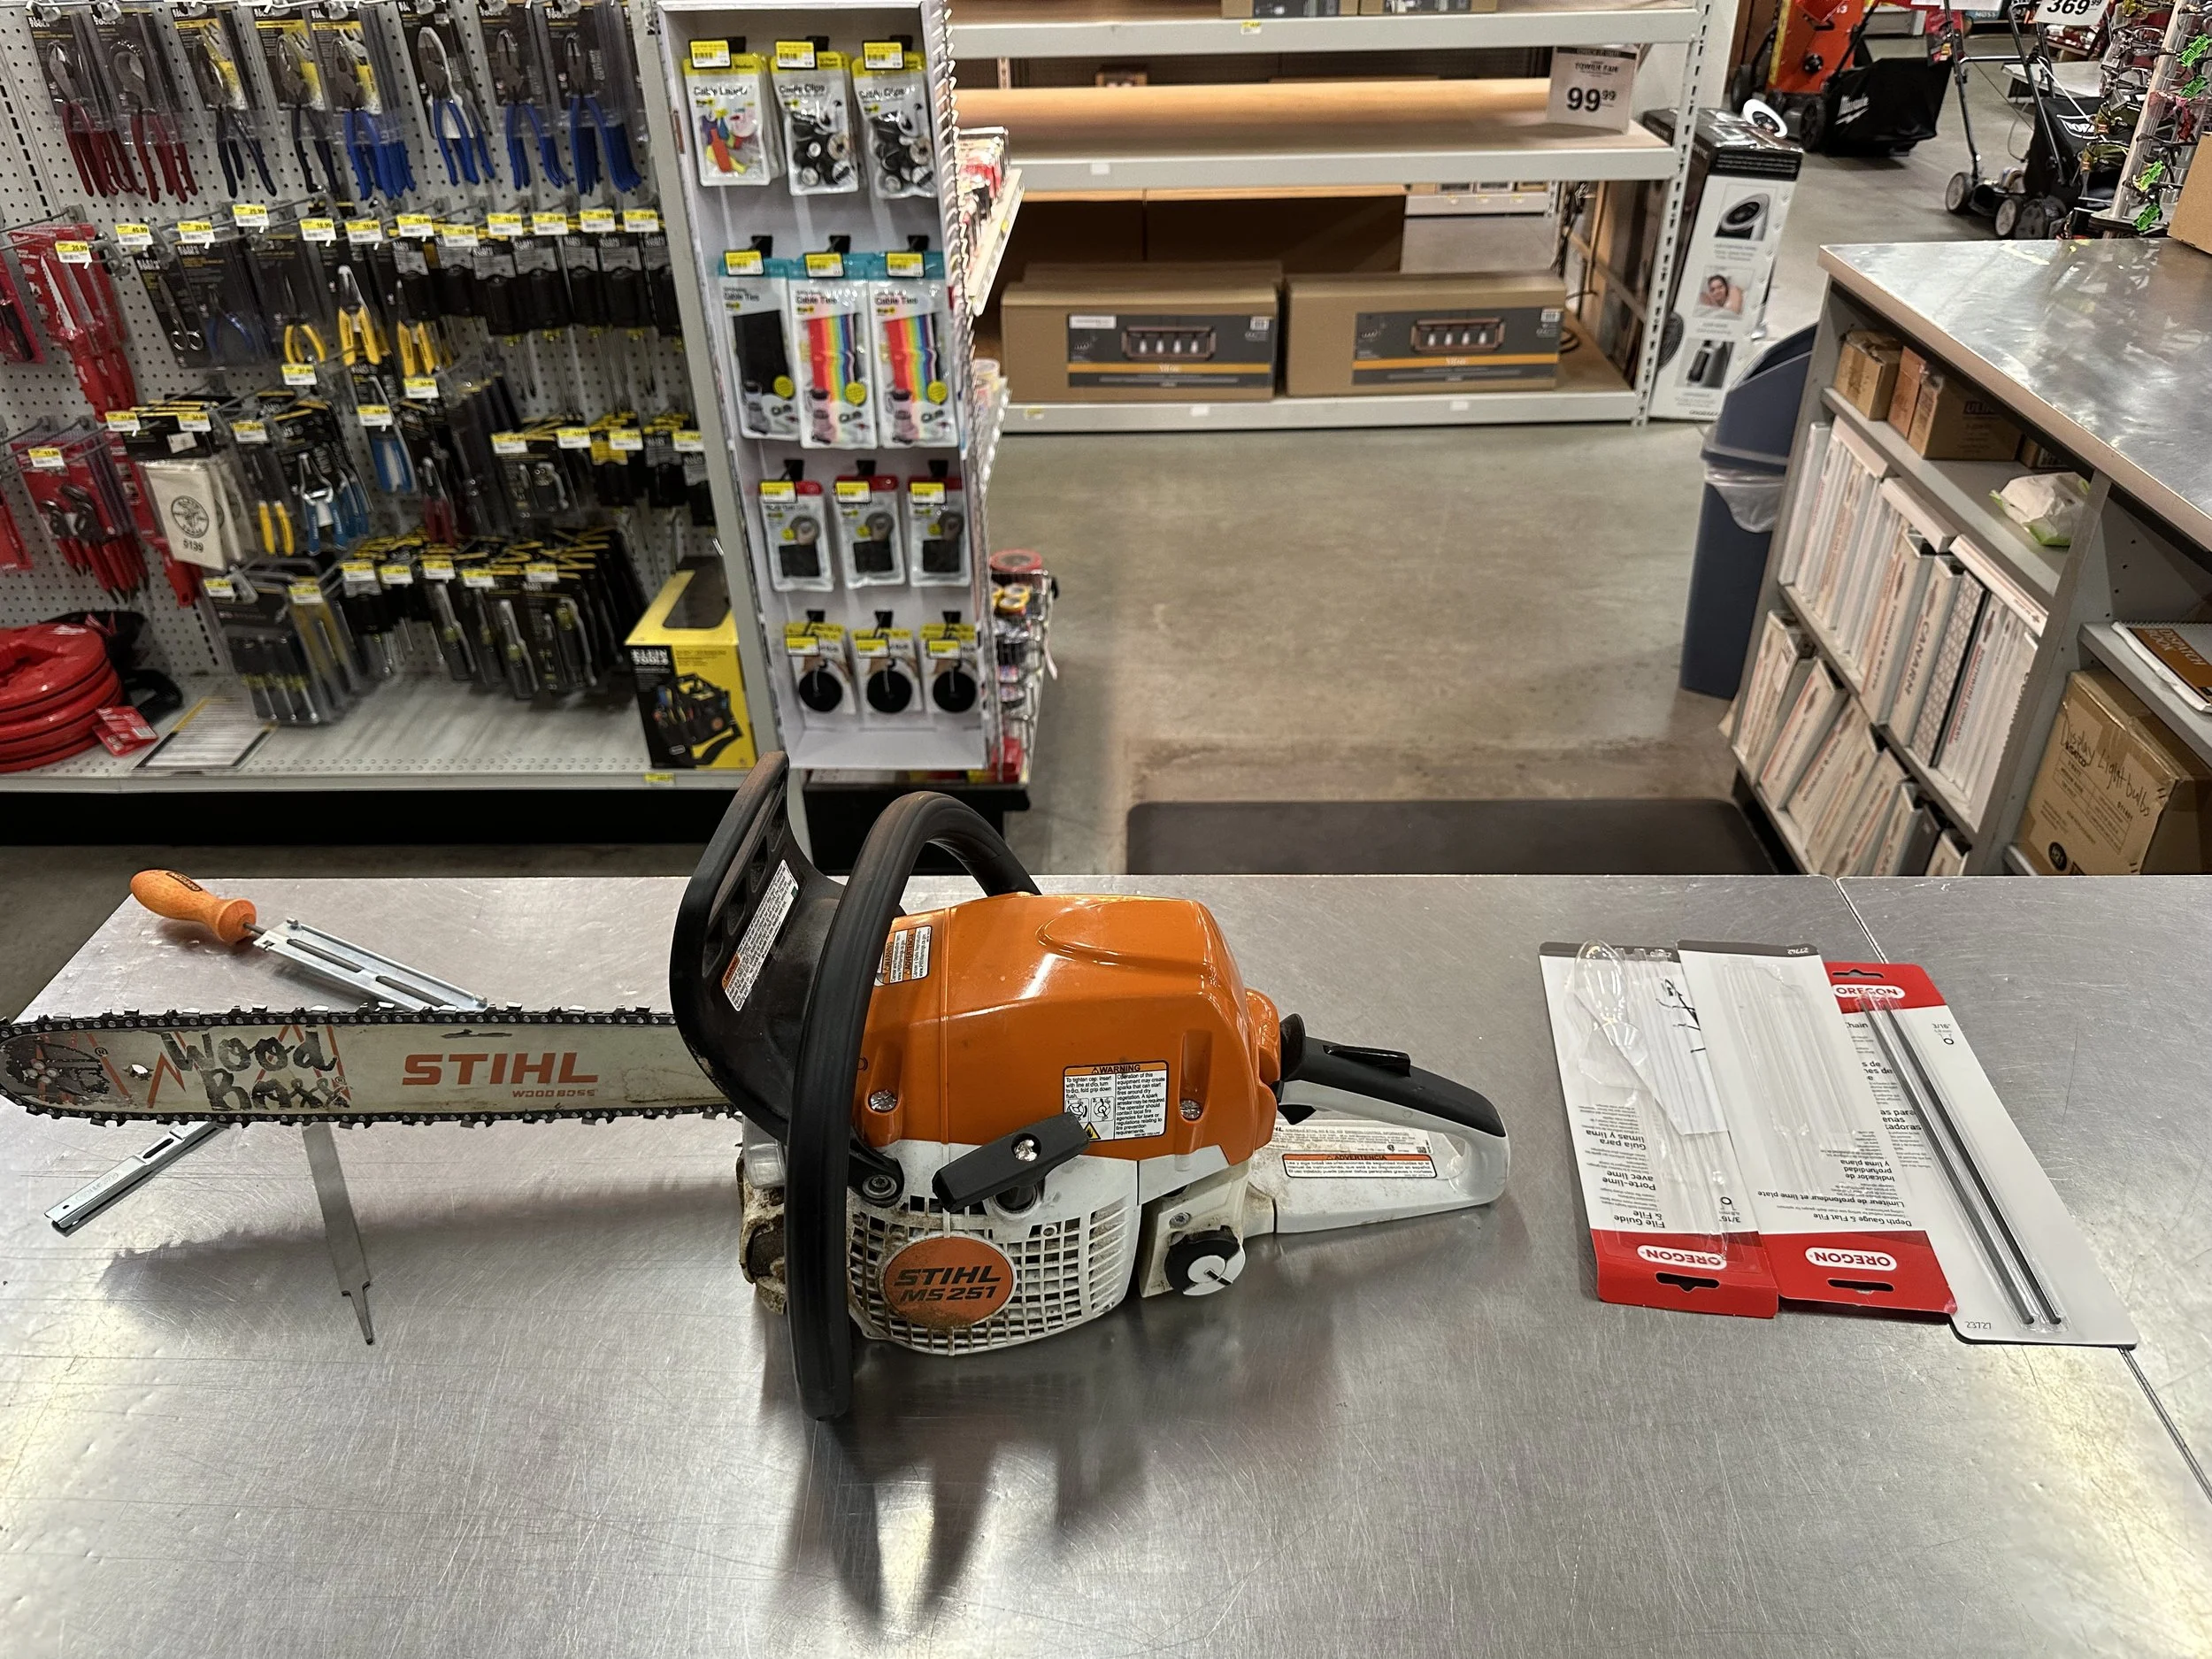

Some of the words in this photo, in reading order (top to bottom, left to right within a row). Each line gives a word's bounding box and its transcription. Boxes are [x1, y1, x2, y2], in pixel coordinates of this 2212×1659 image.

[2047, 0, 2089, 15] 369
[1566, 87, 1601, 111] 99
[182, 538, 204, 553] 5139
[1904, 621, 1930, 695] CANARM
[2098, 749, 2126, 790] Light
[1836, 987, 1898, 996] OREGON
[160, 1024, 339, 1072] Wood
[402, 1052, 599, 1086] STIHL
[1099, 1064, 1141, 1073] WARNING
[512, 1089, 554, 1098] WOOD
[1586, 1129, 1608, 1139] lima
[1617, 1133, 1645, 1143] limas
[1599, 1138, 1622, 1148] para
[1606, 1171, 1628, 1179] lime
[1843, 1166, 1892, 1175] profundidad
[1630, 1173, 1654, 1182] avec
[1856, 1173, 1895, 1182] Indicador
[1601, 1177, 1656, 1191] Porte-lime
[1757, 1190, 1778, 1199] plate
[1810, 1194, 1855, 1203] profondeur
[1870, 1199, 1905, 1209] Limiteur
[1613, 1214, 1642, 1225] Guide
[1632, 1210, 1652, 1219] File
[1646, 1219, 1665, 1229] File
[1858, 1215, 1885, 1225] Gauge
[1886, 1217, 1912, 1227] Depth
[1646, 1248, 1722, 1266] OREGON
[1813, 1250, 1891, 1267] OREGON
[894, 1265, 1002, 1286] STIHL
[900, 1287, 944, 1302] MS
[946, 1286, 997, 1301] 251
